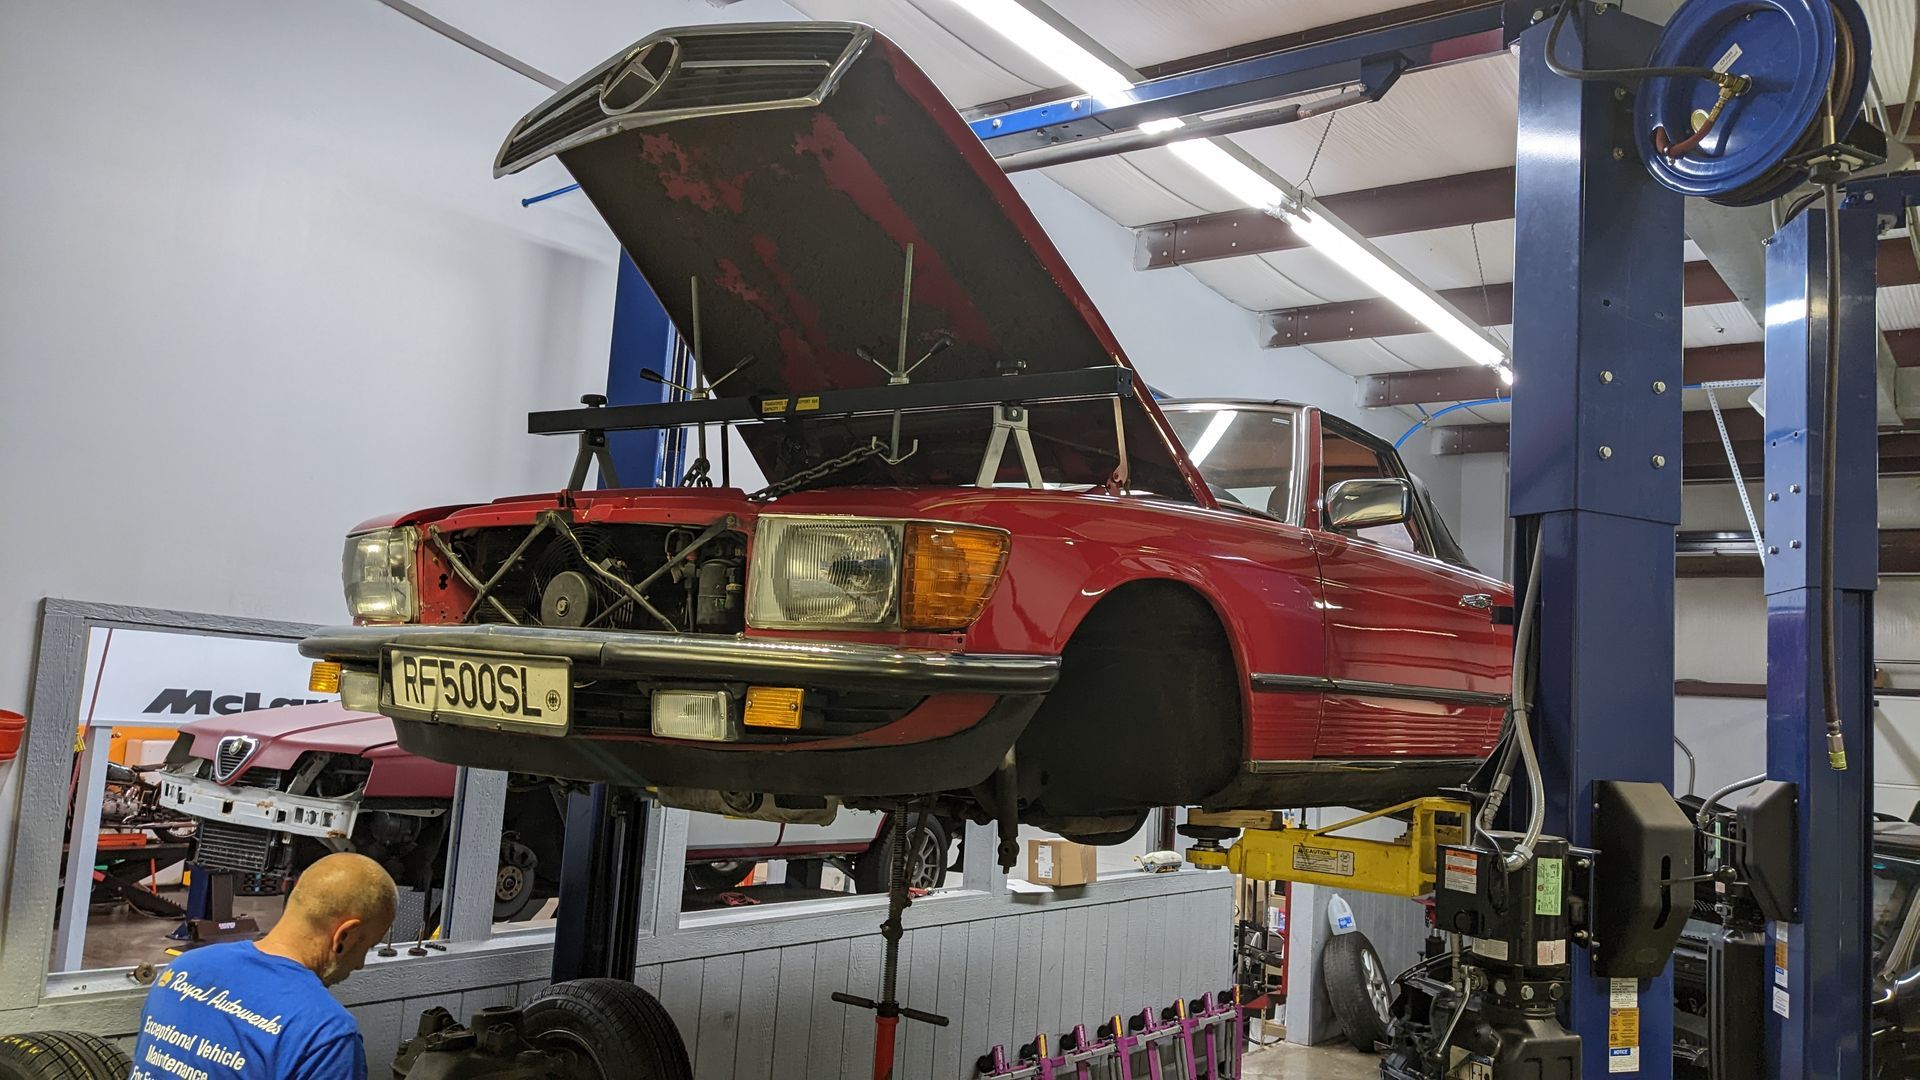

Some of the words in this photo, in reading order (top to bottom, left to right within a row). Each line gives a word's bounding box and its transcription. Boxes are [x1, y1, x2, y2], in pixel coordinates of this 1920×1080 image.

[1305, 848, 1330, 856] CAUTION
[169, 971, 216, 1002] Royal
[206, 990, 283, 1035] Autowerks
[143, 1016, 198, 1051] Exceptional
[196, 1038, 246, 1071] Vehicle
[145, 1044, 209, 1080] Maintenance
